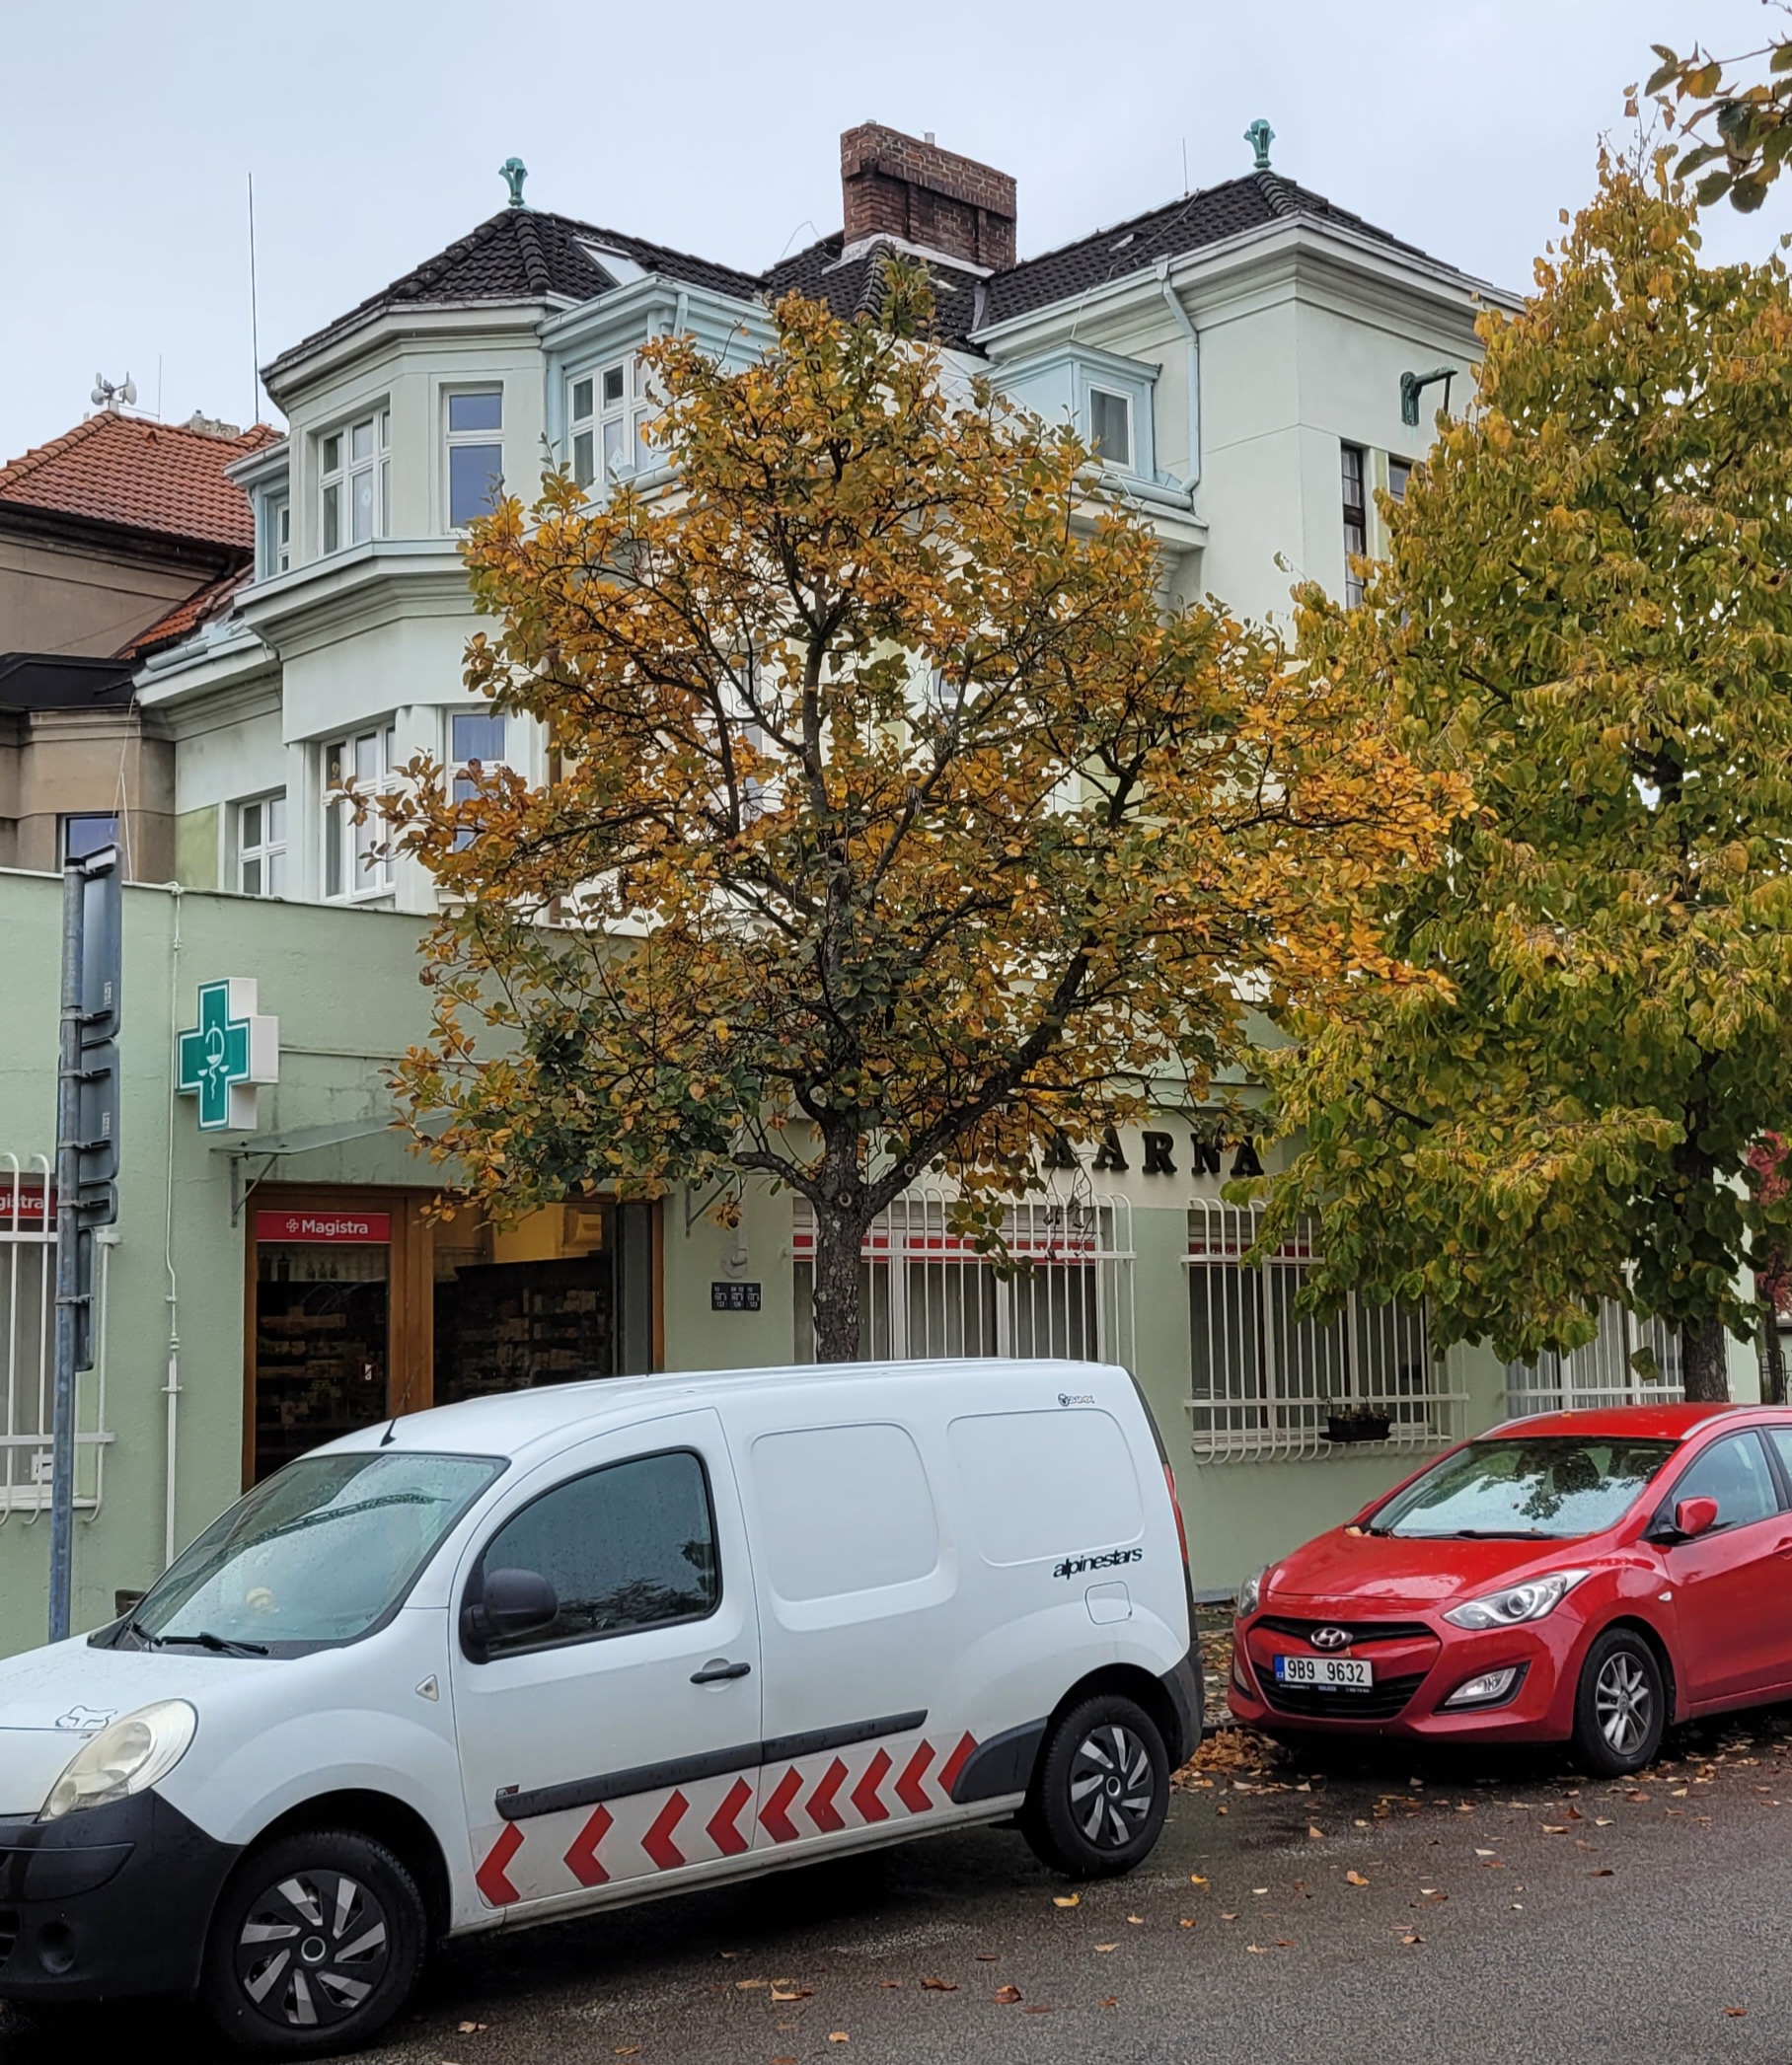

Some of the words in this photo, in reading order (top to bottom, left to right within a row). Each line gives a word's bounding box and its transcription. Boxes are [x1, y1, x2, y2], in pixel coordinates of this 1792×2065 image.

[301, 1219, 368, 1236] Magistra
[1053, 1548, 1143, 1581] alpinestars
[1288, 1659, 1315, 1680] 9B9
[1326, 1661, 1365, 1683] 9632
